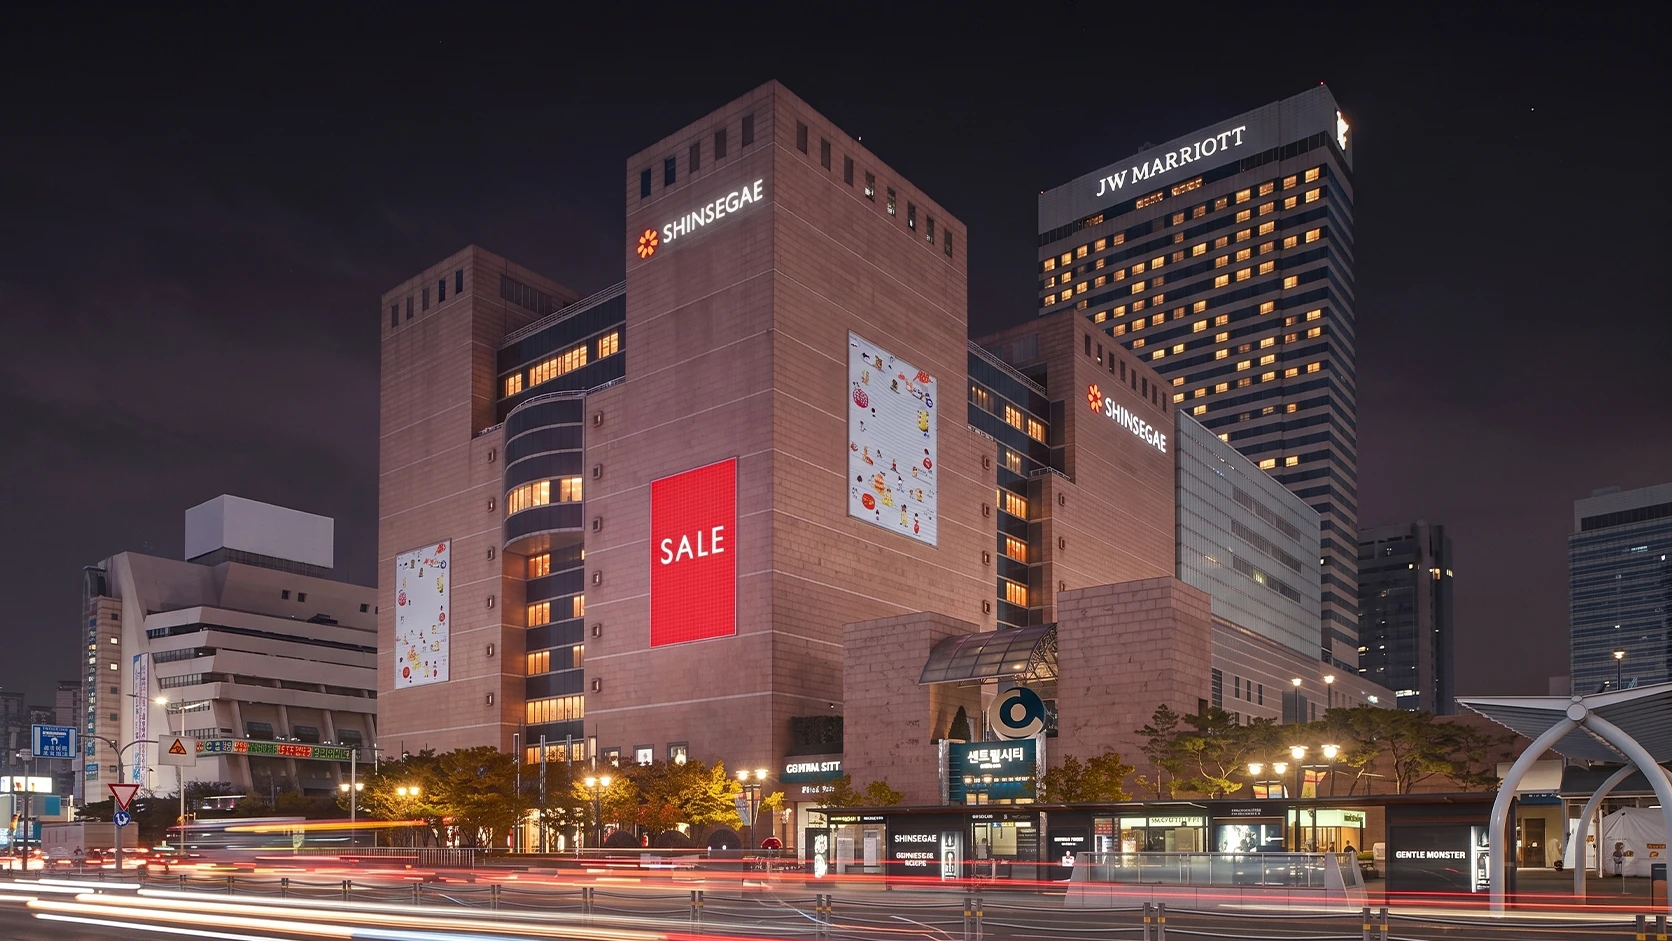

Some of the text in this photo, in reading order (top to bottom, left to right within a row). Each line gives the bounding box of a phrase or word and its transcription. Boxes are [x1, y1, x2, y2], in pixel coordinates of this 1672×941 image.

[1096, 125, 1246, 197] JW MARRIOTT
[663, 179, 763, 243] SHINSEGAE
[1105, 397, 1167, 453] SHINSEGAE
[660, 525, 725, 565] SALE
[894, 834, 937, 843] SHINSEGAE
[1395, 850, 1466, 859] GENTLE MONSTER
